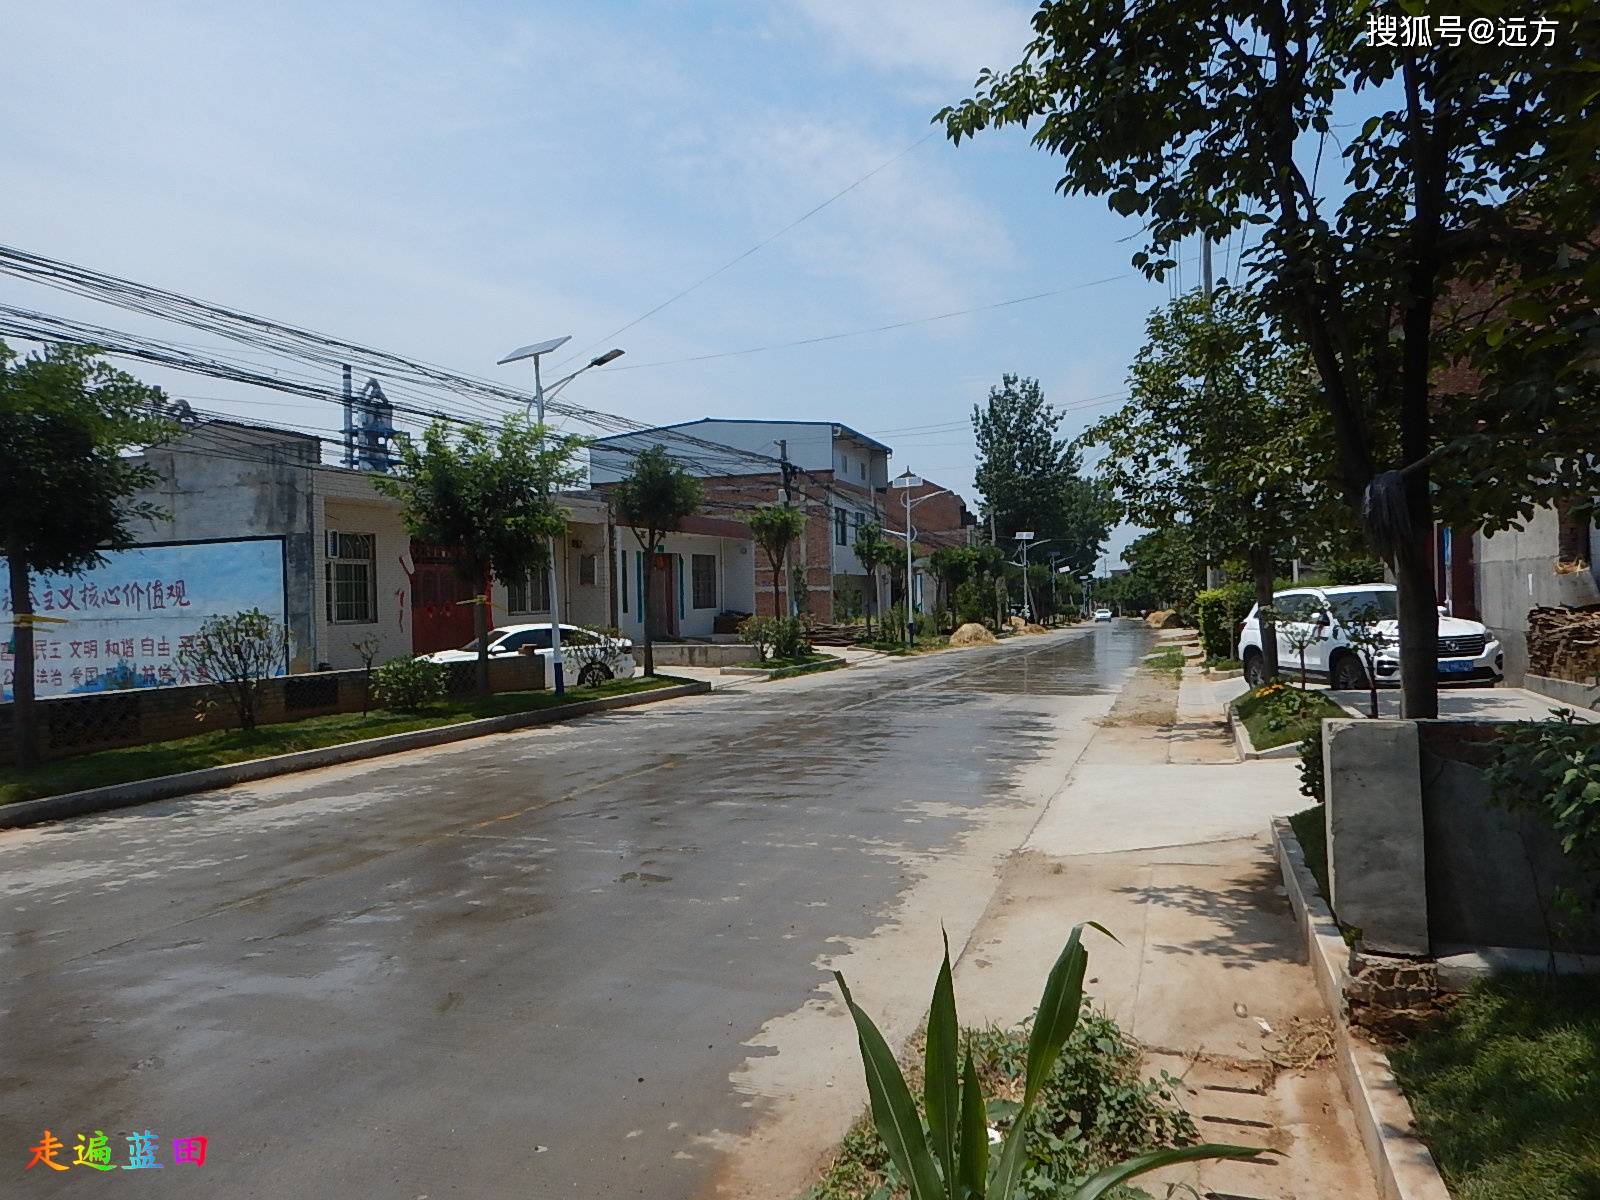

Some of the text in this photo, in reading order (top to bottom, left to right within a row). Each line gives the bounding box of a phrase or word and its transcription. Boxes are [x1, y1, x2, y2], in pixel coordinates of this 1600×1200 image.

[2, 579, 191, 611] 主义核心价值观
[69, 639, 98, 659] 文明
[104, 638, 134, 658] 和谐
[141, 635, 170, 657] 自由
